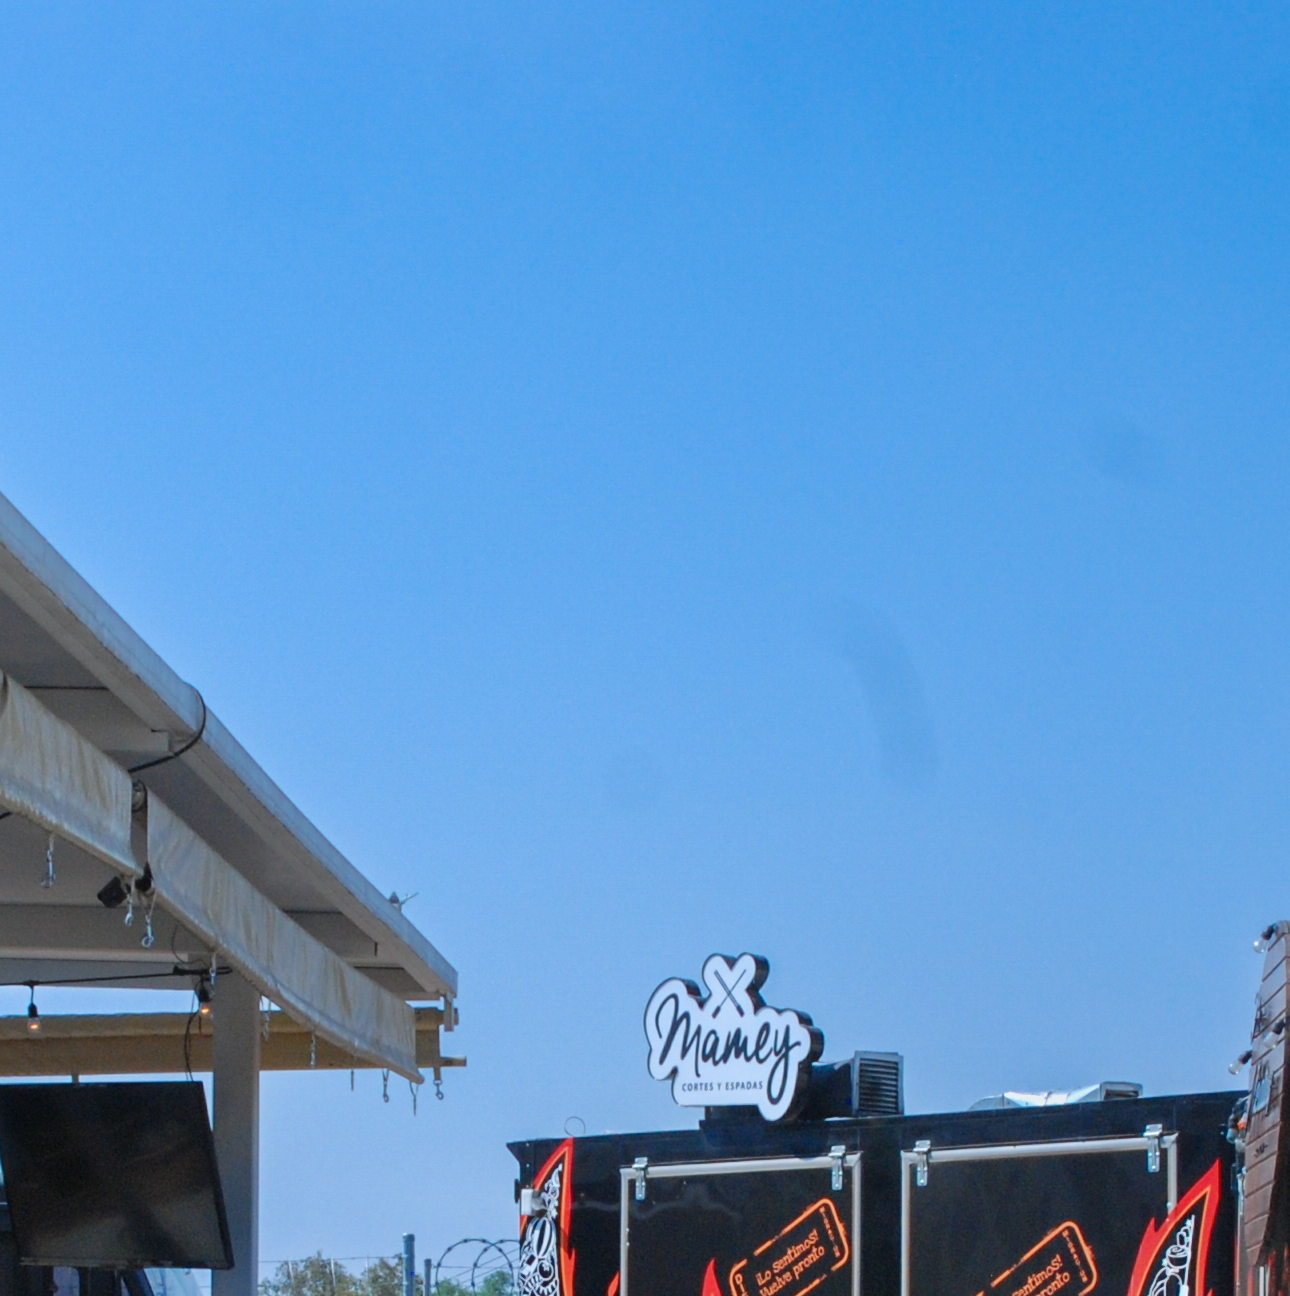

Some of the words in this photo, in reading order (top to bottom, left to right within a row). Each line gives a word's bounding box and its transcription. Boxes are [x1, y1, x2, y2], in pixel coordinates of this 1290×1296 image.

[655, 993, 802, 1106] Mamey
[682, 1081, 714, 1092] CORTES
[717, 1081, 723, 1091] Y
[725, 1080, 763, 1091] ESPADAS
[793, 1245, 826, 1280] pronto
